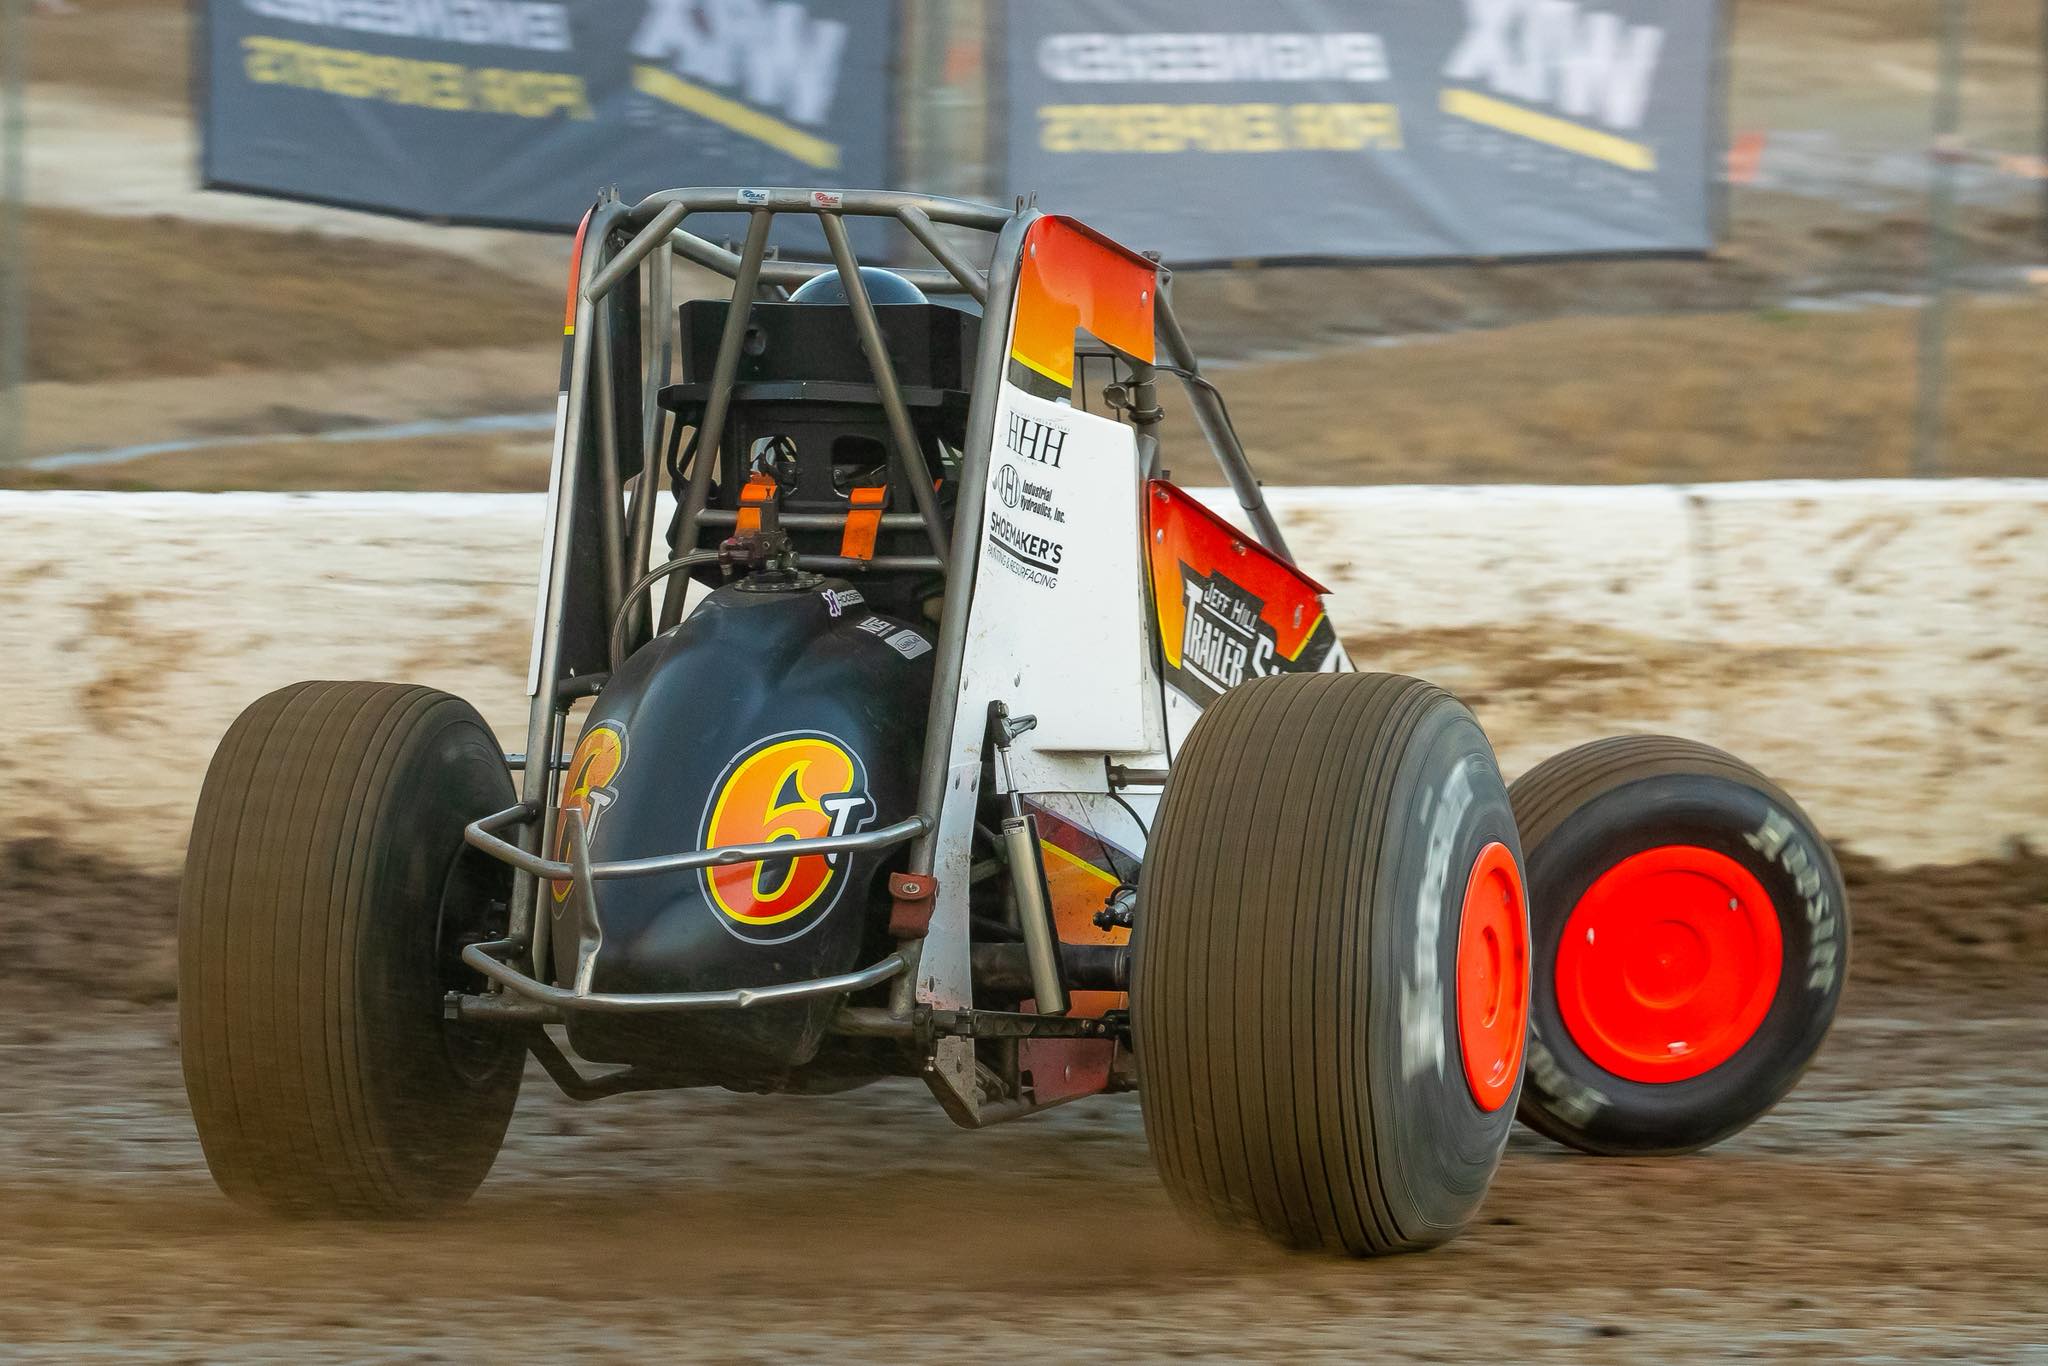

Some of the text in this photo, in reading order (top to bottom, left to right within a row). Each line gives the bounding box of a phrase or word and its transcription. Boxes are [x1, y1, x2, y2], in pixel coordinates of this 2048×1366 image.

[1006, 410, 1069, 469] HHH
[1022, 479, 1053, 503] Industrial
[1054, 507, 1066, 524] Inc.
[990, 511, 1063, 564] SHOEMAKER'S
[1009, 559, 1058, 589] RESURFACING
[1204, 582, 1258, 633] JEFF HILL
